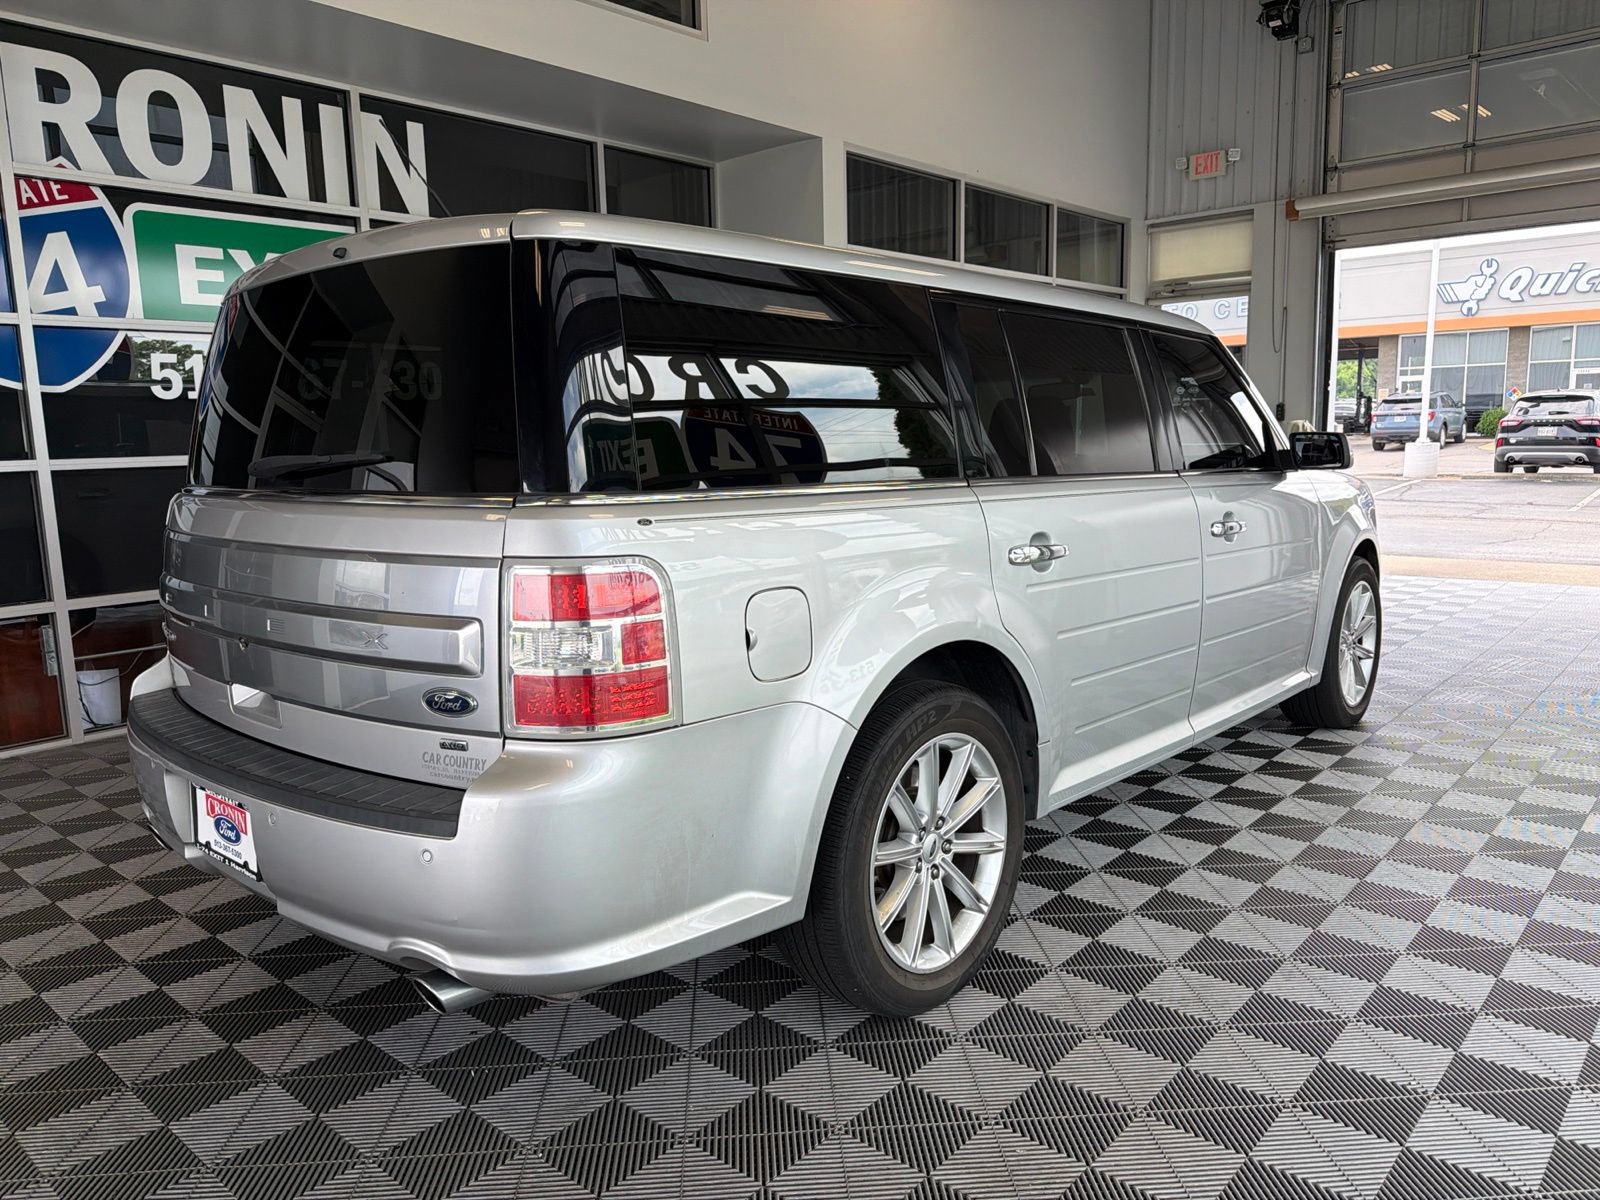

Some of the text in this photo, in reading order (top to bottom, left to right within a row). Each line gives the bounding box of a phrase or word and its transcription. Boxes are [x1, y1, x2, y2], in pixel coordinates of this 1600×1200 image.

[1194, 151, 1221, 175] EXIT
[1499, 262, 1600, 302] Quic
[432, 694, 463, 711] Ford
[422, 751, 442, 766] CAR
[443, 754, 487, 771] COUNTRY
[207, 797, 247, 834] CRONIN
[219, 819, 237, 841] Ford
